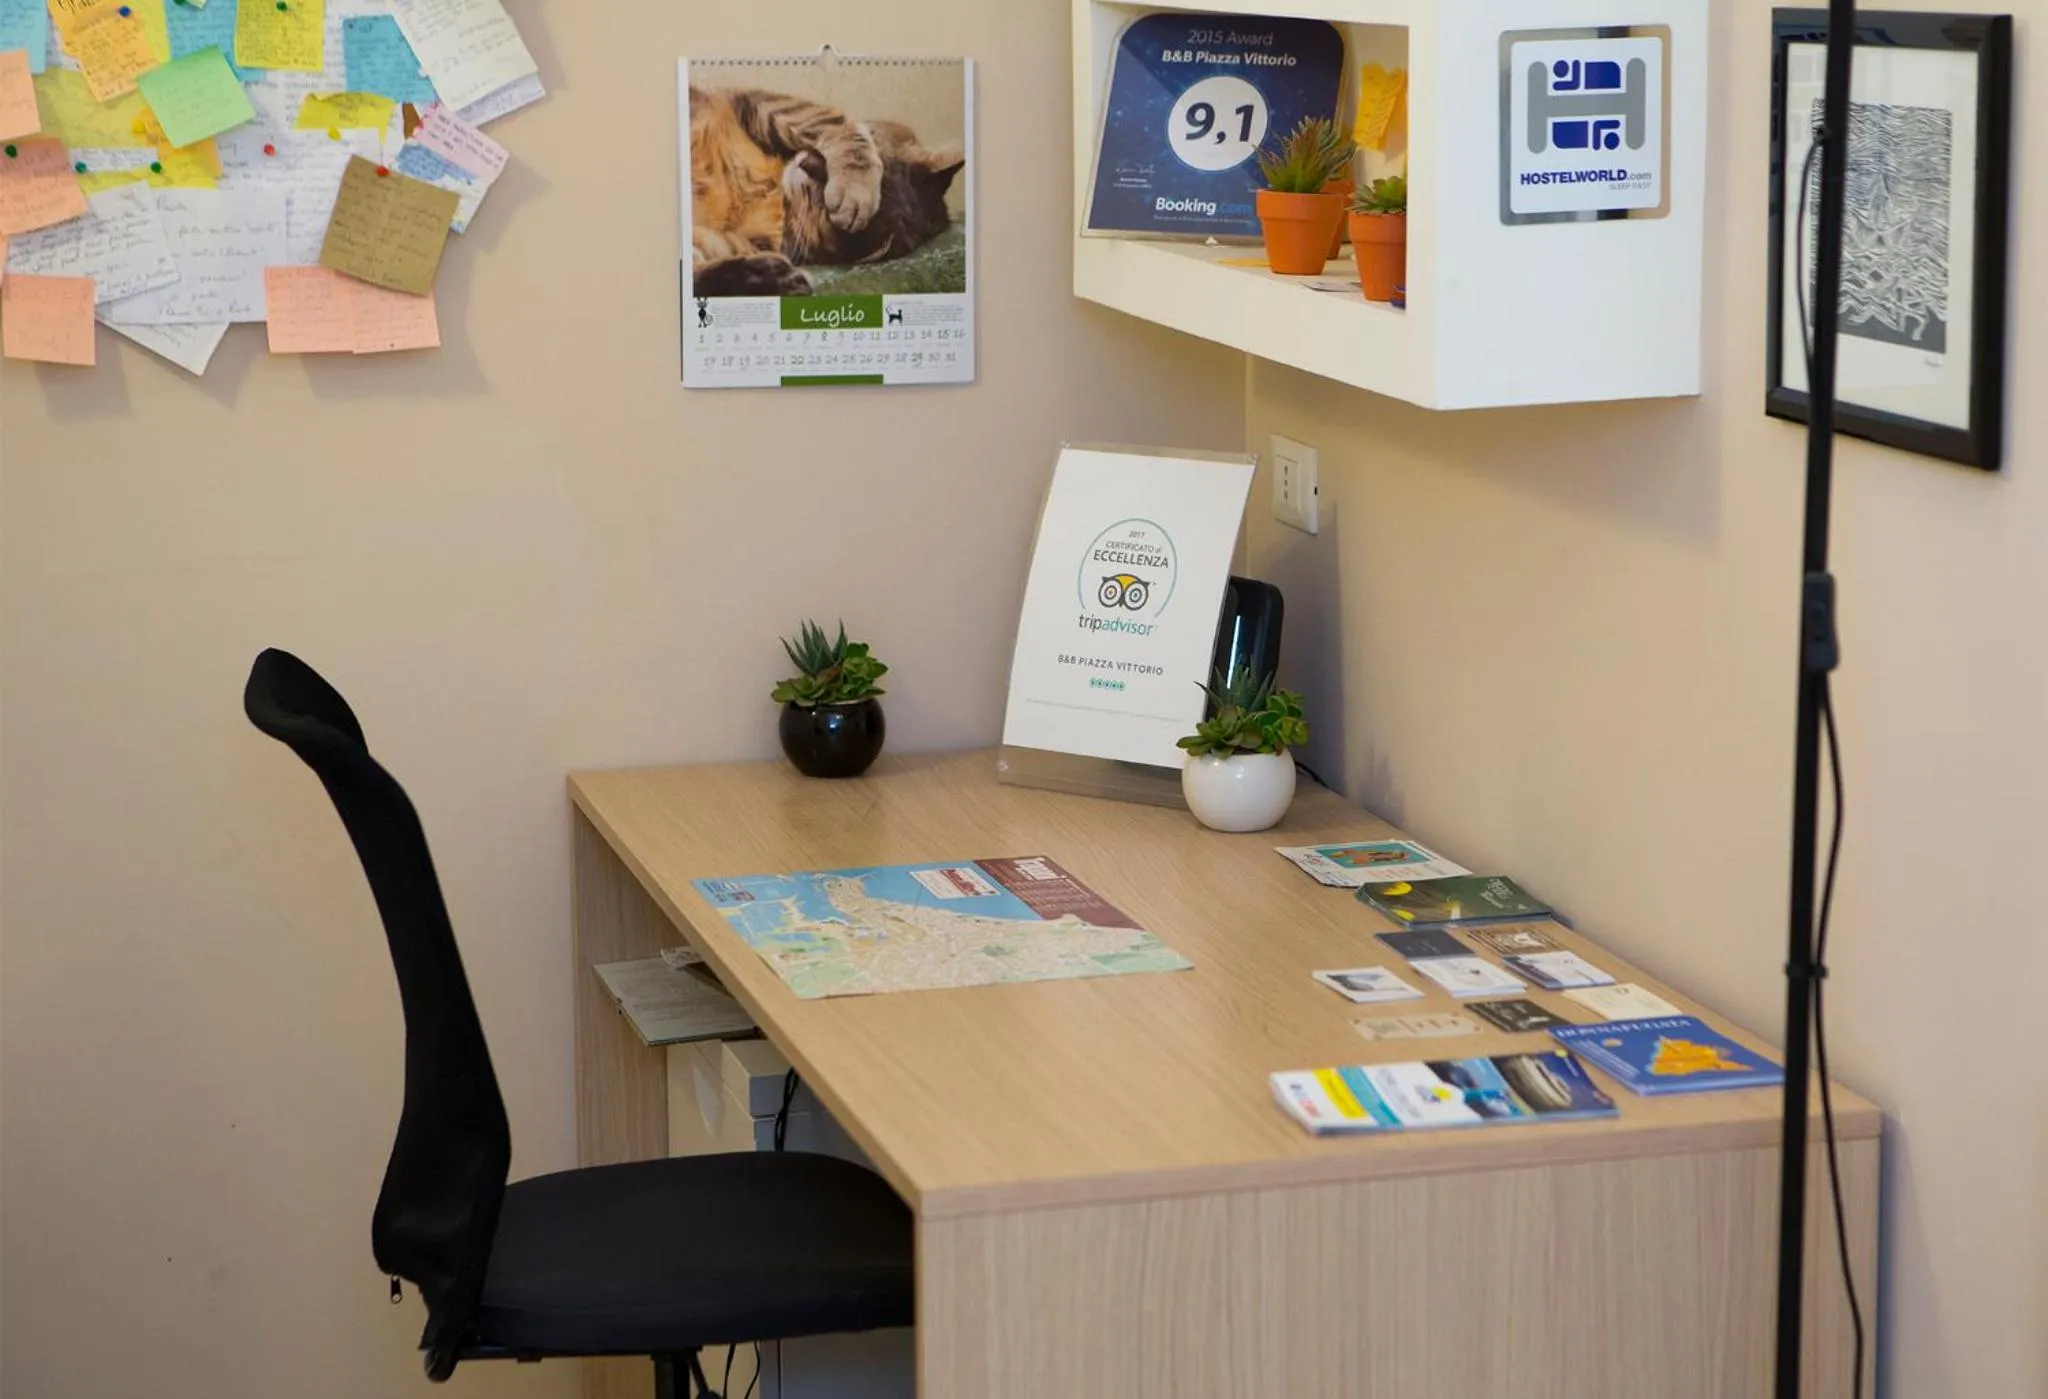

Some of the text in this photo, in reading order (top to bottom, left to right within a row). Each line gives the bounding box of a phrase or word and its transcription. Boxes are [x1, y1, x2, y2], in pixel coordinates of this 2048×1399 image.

[1187, 29, 1274, 46] 2015 Award
[1162, 50, 1297, 67] B&B Piazza Vittorio
[1184, 102, 1255, 145] 9,1
[800, 304, 865, 328] Luglio
[1105, 541, 1154, 553] CERTIFICATO
[1093, 549, 1169, 569] ECCELLENZA
[1079, 614, 1153, 636] tripadvisor
[1057, 654, 1164, 676] B&B PIAZZA VITTORIO
